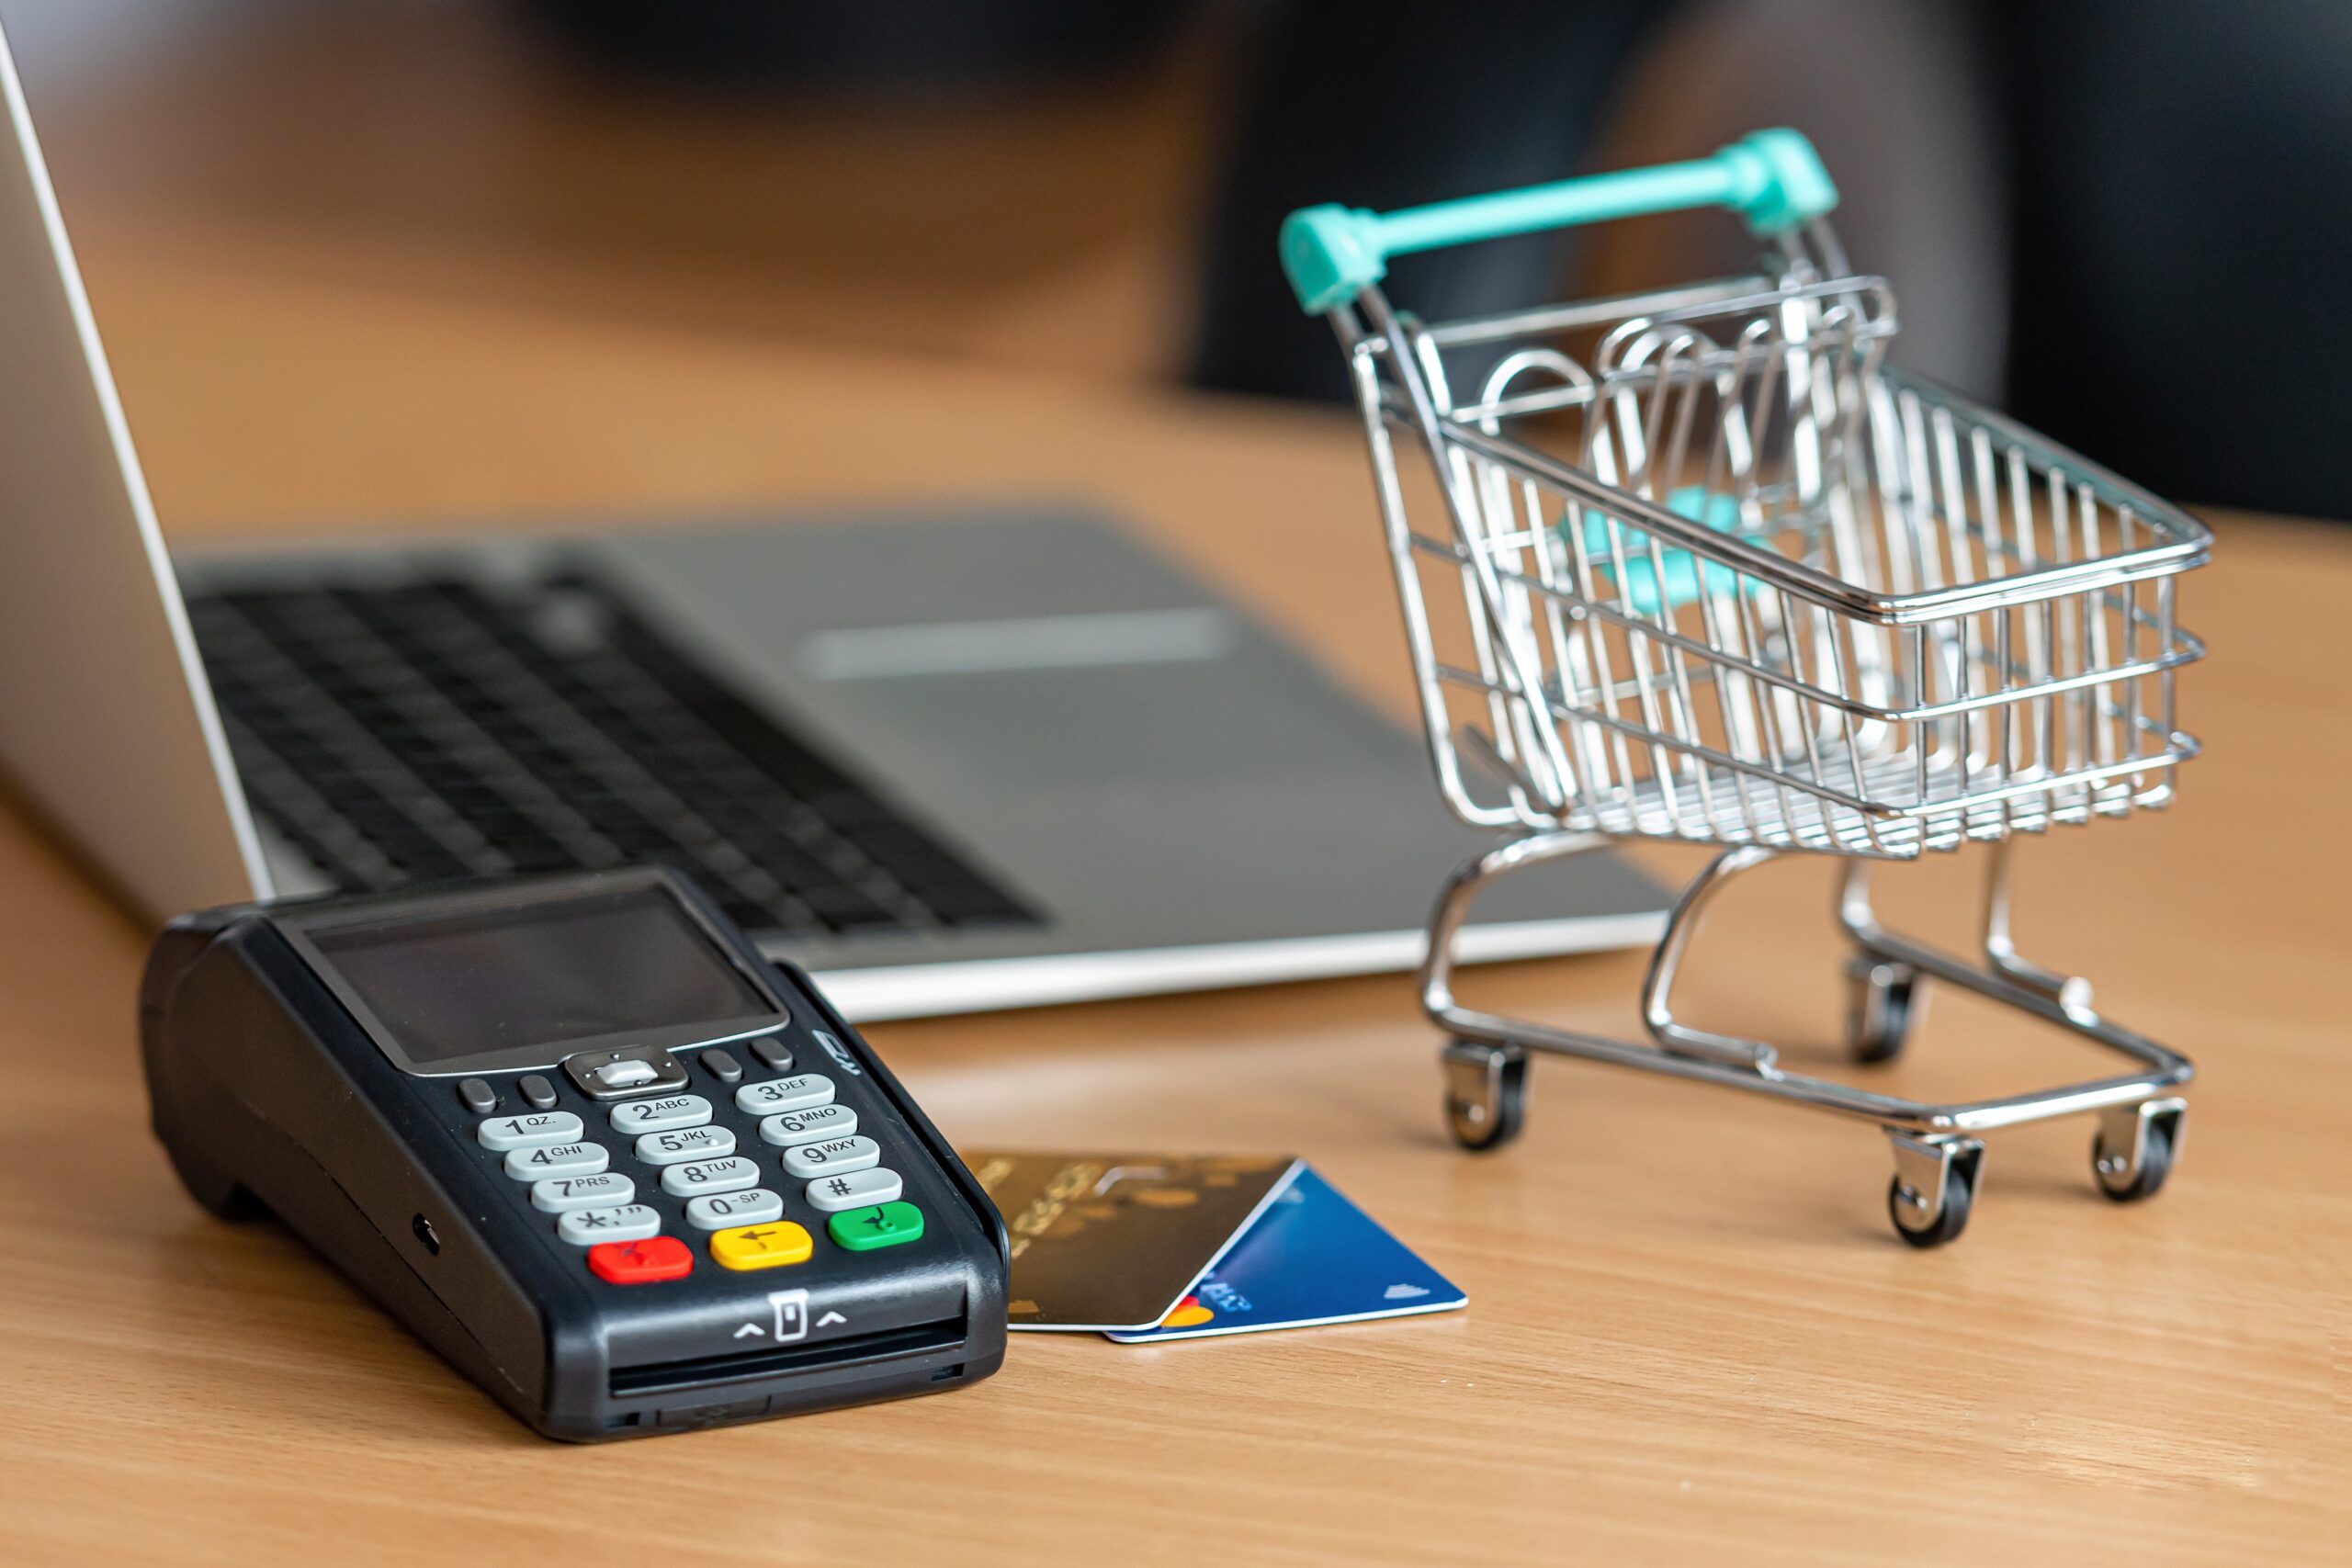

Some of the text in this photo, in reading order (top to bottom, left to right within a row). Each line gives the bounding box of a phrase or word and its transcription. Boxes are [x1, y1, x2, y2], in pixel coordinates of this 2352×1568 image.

[758, 1077, 808, 1100] 3 DEF
[632, 1098, 690, 1120] 2 ABC
[505, 1119, 525, 1134] 1
[780, 1108, 837, 1132] 6 MNO
[659, 1130, 712, 1151] 5 JKL
[802, 1139, 856, 1163] 9 WXY
[531, 1145, 582, 1165] 4 GHI
[683, 1159, 737, 1182] 8 TUV
[552, 1177, 610, 1196] 7 PRS
[709, 1198, 732, 1215] 0
